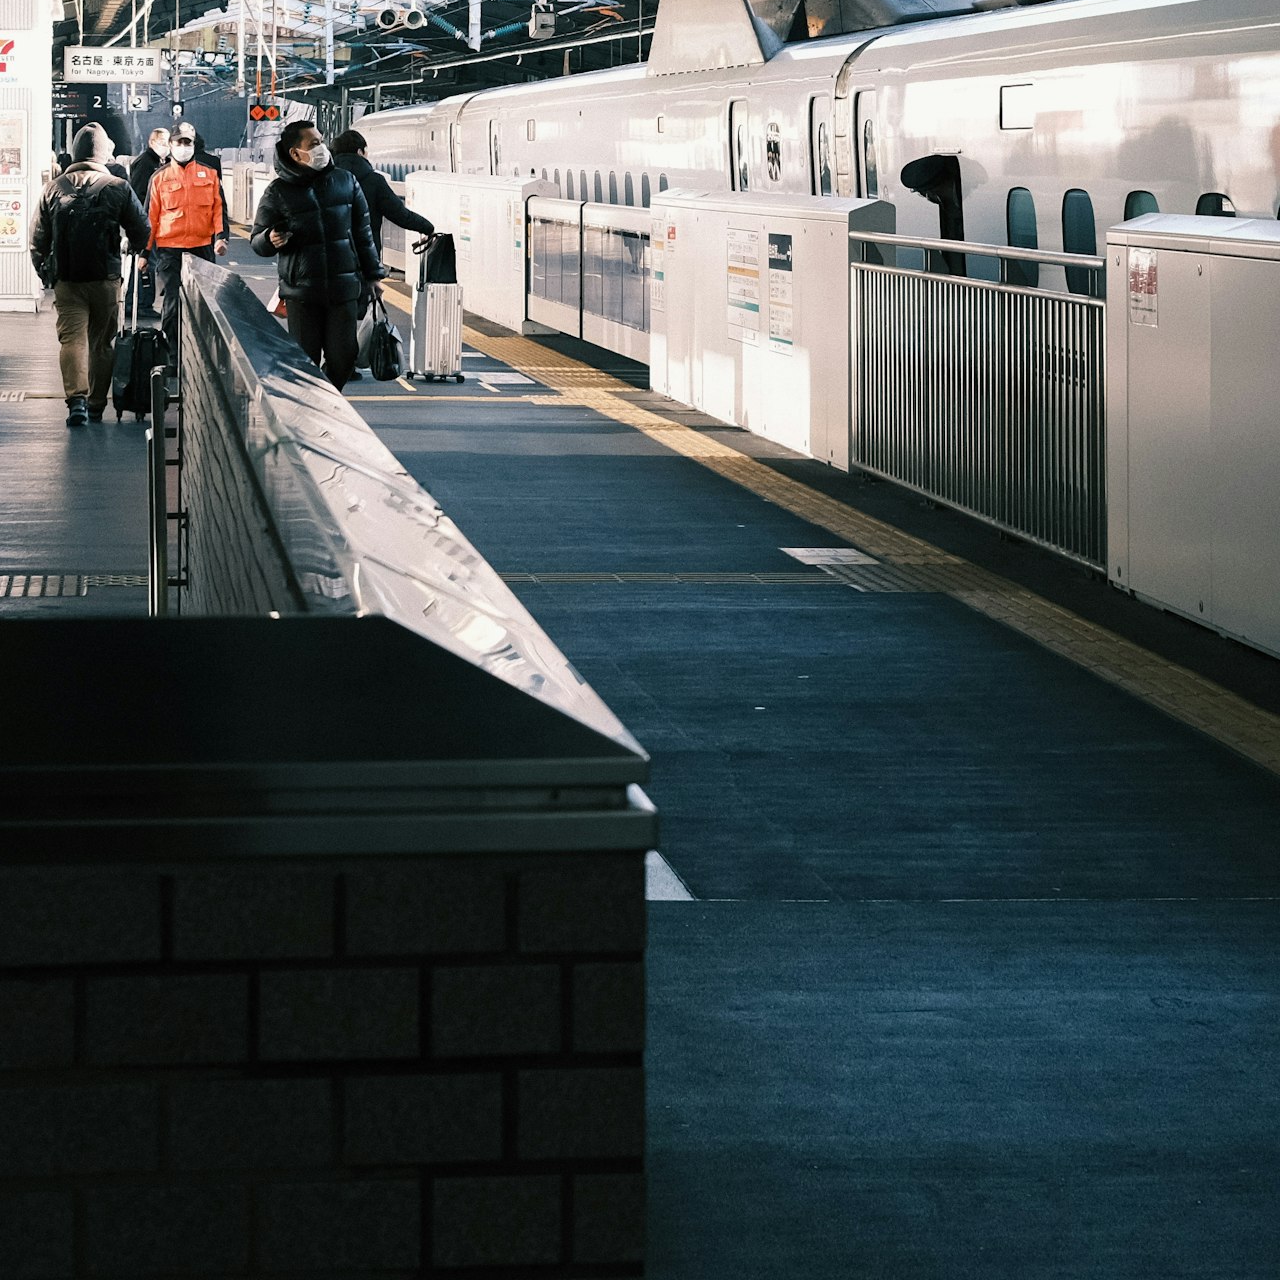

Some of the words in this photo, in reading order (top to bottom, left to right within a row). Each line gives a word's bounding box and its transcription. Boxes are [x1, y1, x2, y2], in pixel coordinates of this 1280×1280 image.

[86, 68, 117, 77] Nagoya,
[122, 68, 144, 77] Tokyo
[92, 95, 103, 108] 2
